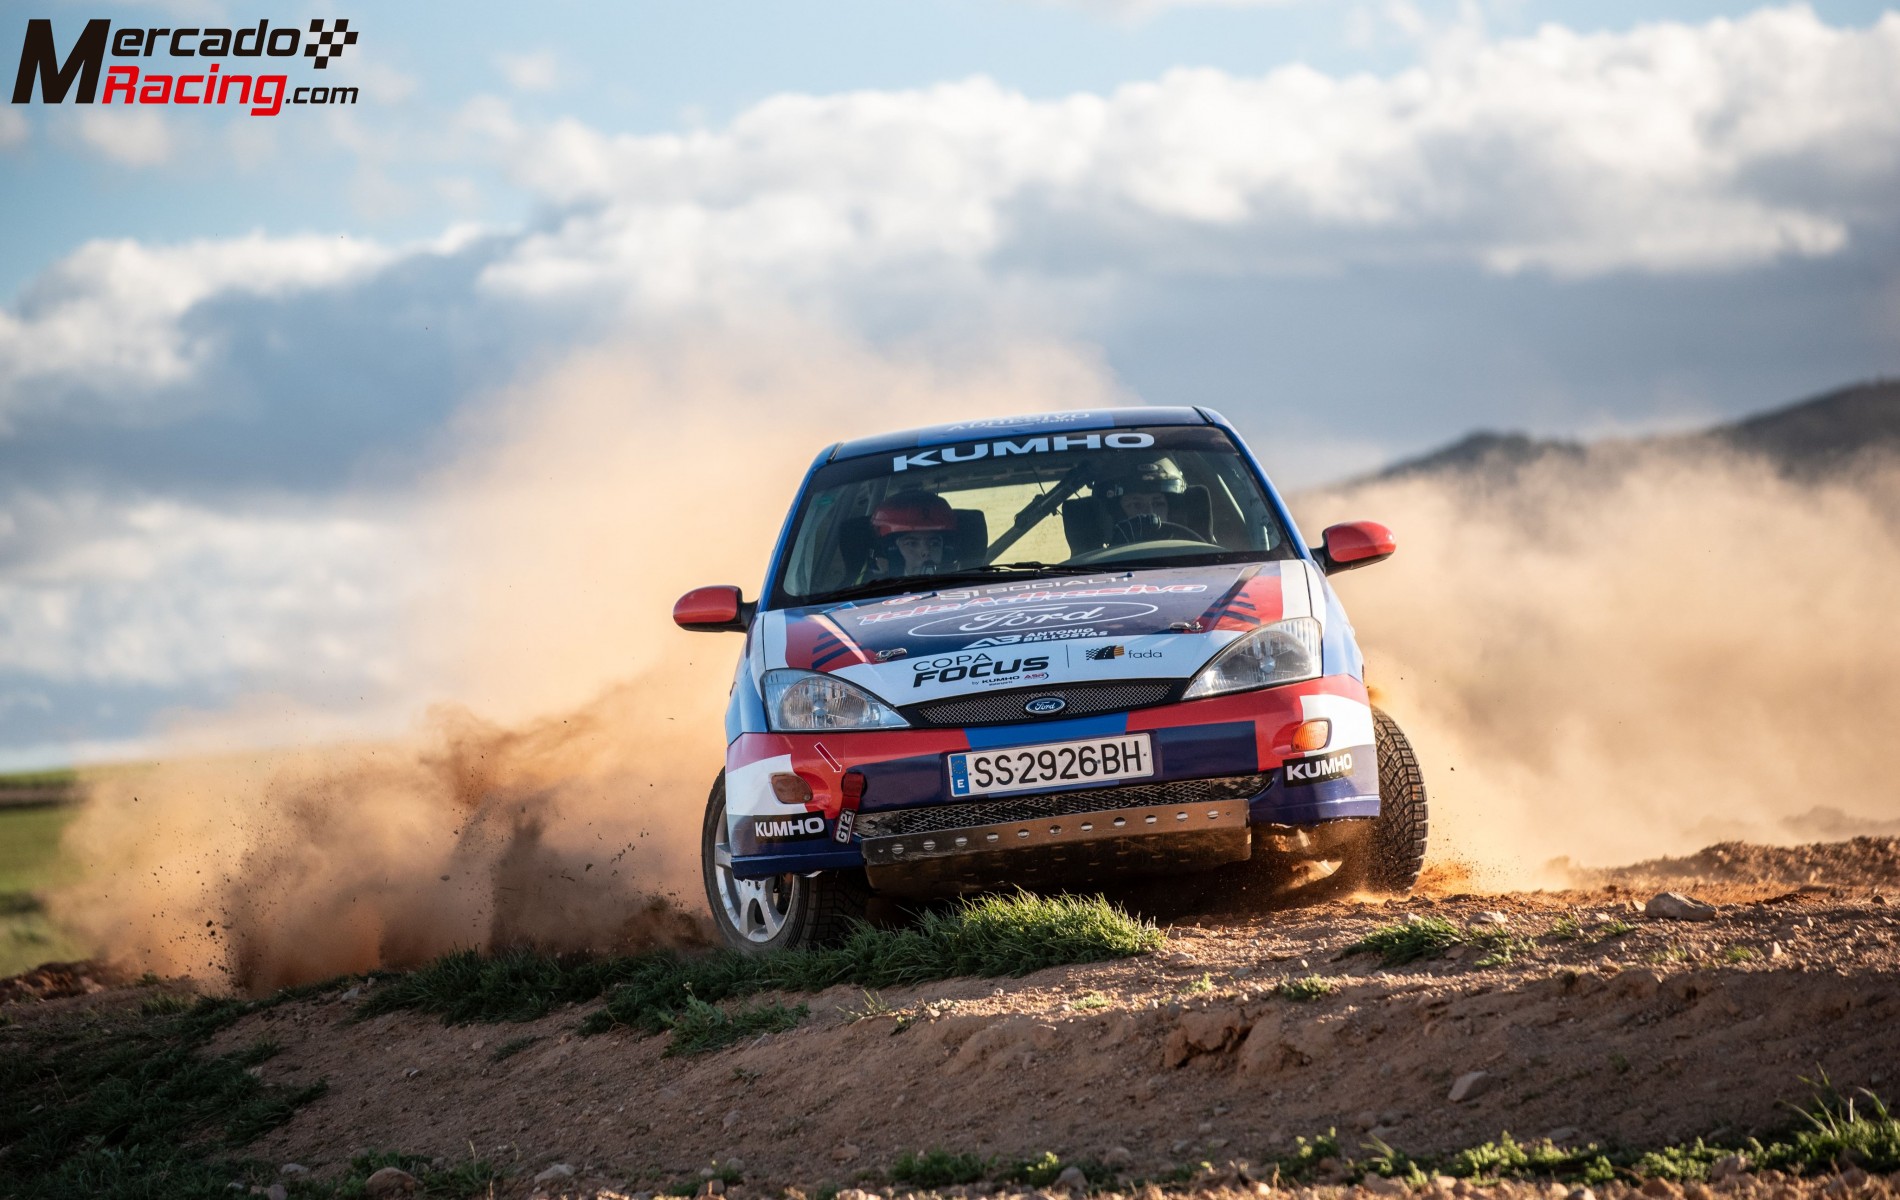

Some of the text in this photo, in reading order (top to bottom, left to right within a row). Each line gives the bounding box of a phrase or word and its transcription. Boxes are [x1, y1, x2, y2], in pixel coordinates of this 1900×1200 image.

[893, 432, 1155, 472] KUMHO
[959, 606, 1106, 631] Ford
[1022, 631, 1109, 643] BELLOSTAS
[1026, 627, 1095, 639] ANTONIO
[913, 652, 993, 671] COPA
[1128, 649, 1163, 659] fada
[913, 656, 1050, 688] FOCUS
[981, 675, 1021, 684] KUMHO
[1286, 753, 1353, 781] KUMHO
[957, 779, 965, 788] E
[754, 817, 825, 837] KUMHO
